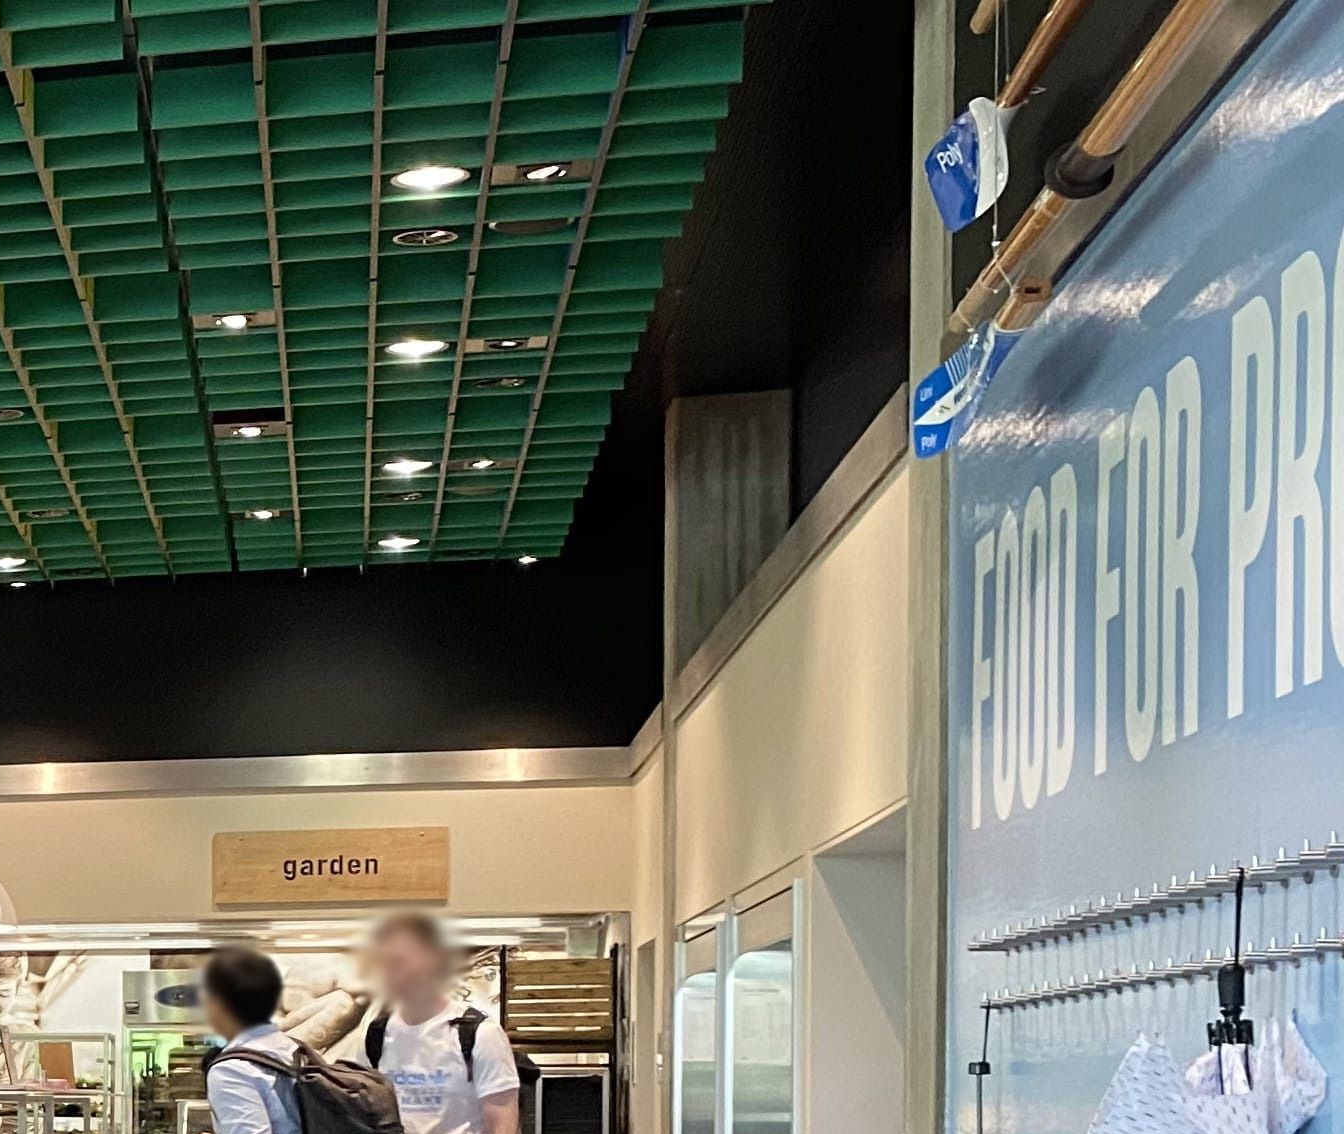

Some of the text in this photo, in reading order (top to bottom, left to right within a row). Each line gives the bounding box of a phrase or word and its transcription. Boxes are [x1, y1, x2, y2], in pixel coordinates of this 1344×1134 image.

[937, 142, 963, 173] Poly
[970, 226, 1344, 830] FOOD FOR PR
[283, 854, 378, 881] garden
